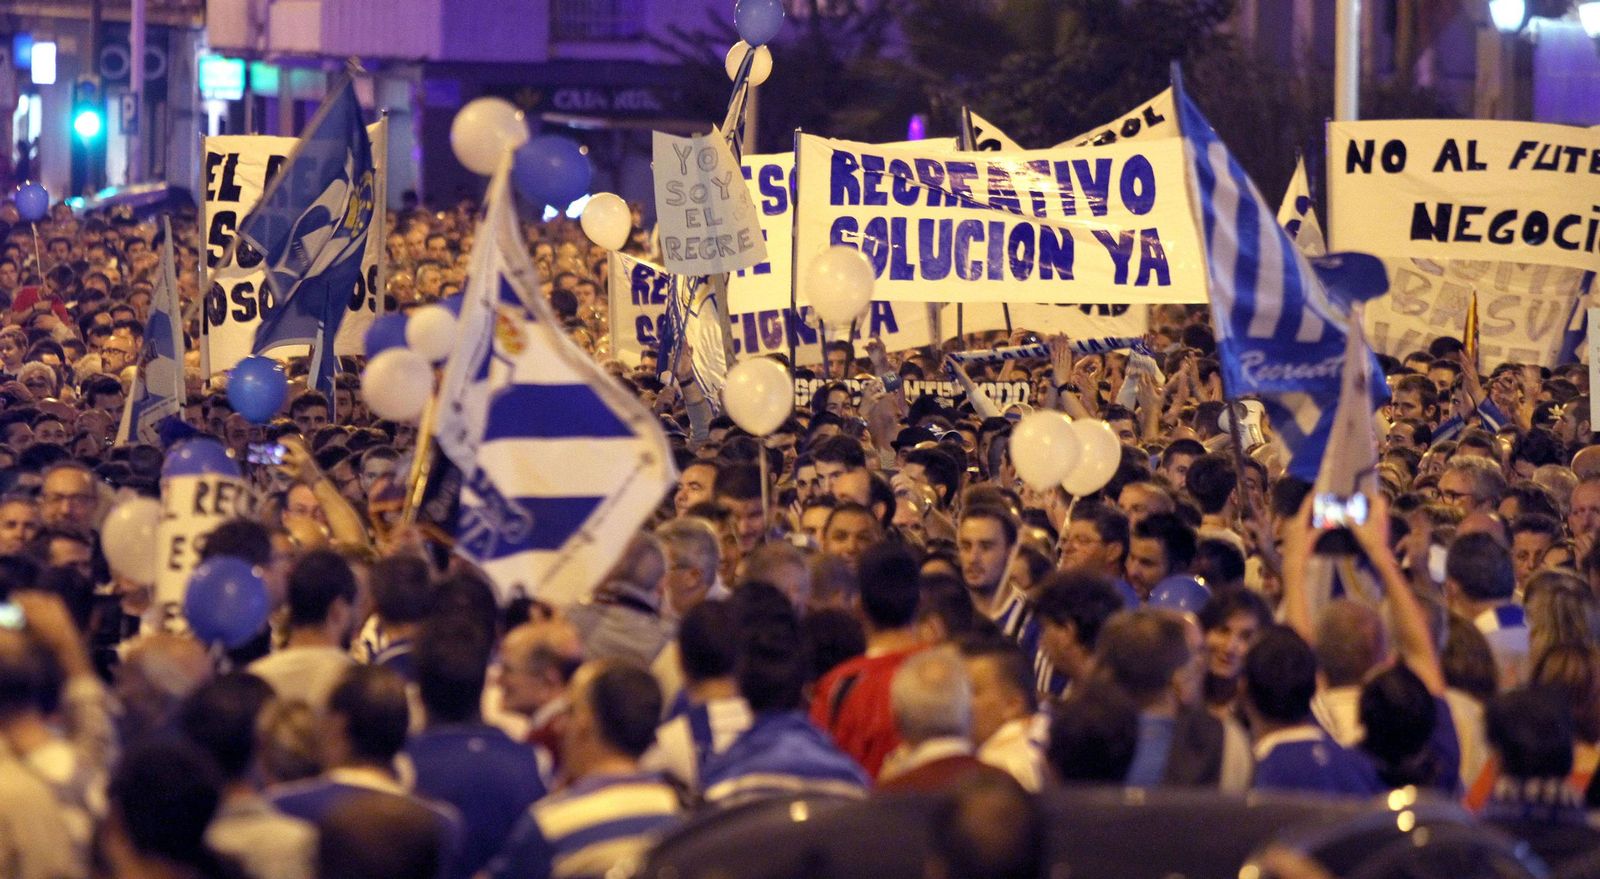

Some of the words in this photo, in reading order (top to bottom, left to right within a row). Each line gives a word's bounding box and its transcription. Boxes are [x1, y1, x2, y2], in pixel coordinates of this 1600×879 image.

[672, 142, 719, 176] YO
[1346, 139, 1407, 174] NO
[1432, 138, 1488, 173] AL
[665, 171, 732, 207] SOY
[829, 149, 1156, 218] RECREATIVO
[686, 208, 722, 230] EL
[829, 216, 1075, 282] SOLUCION
[1091, 228, 1172, 287] YA
